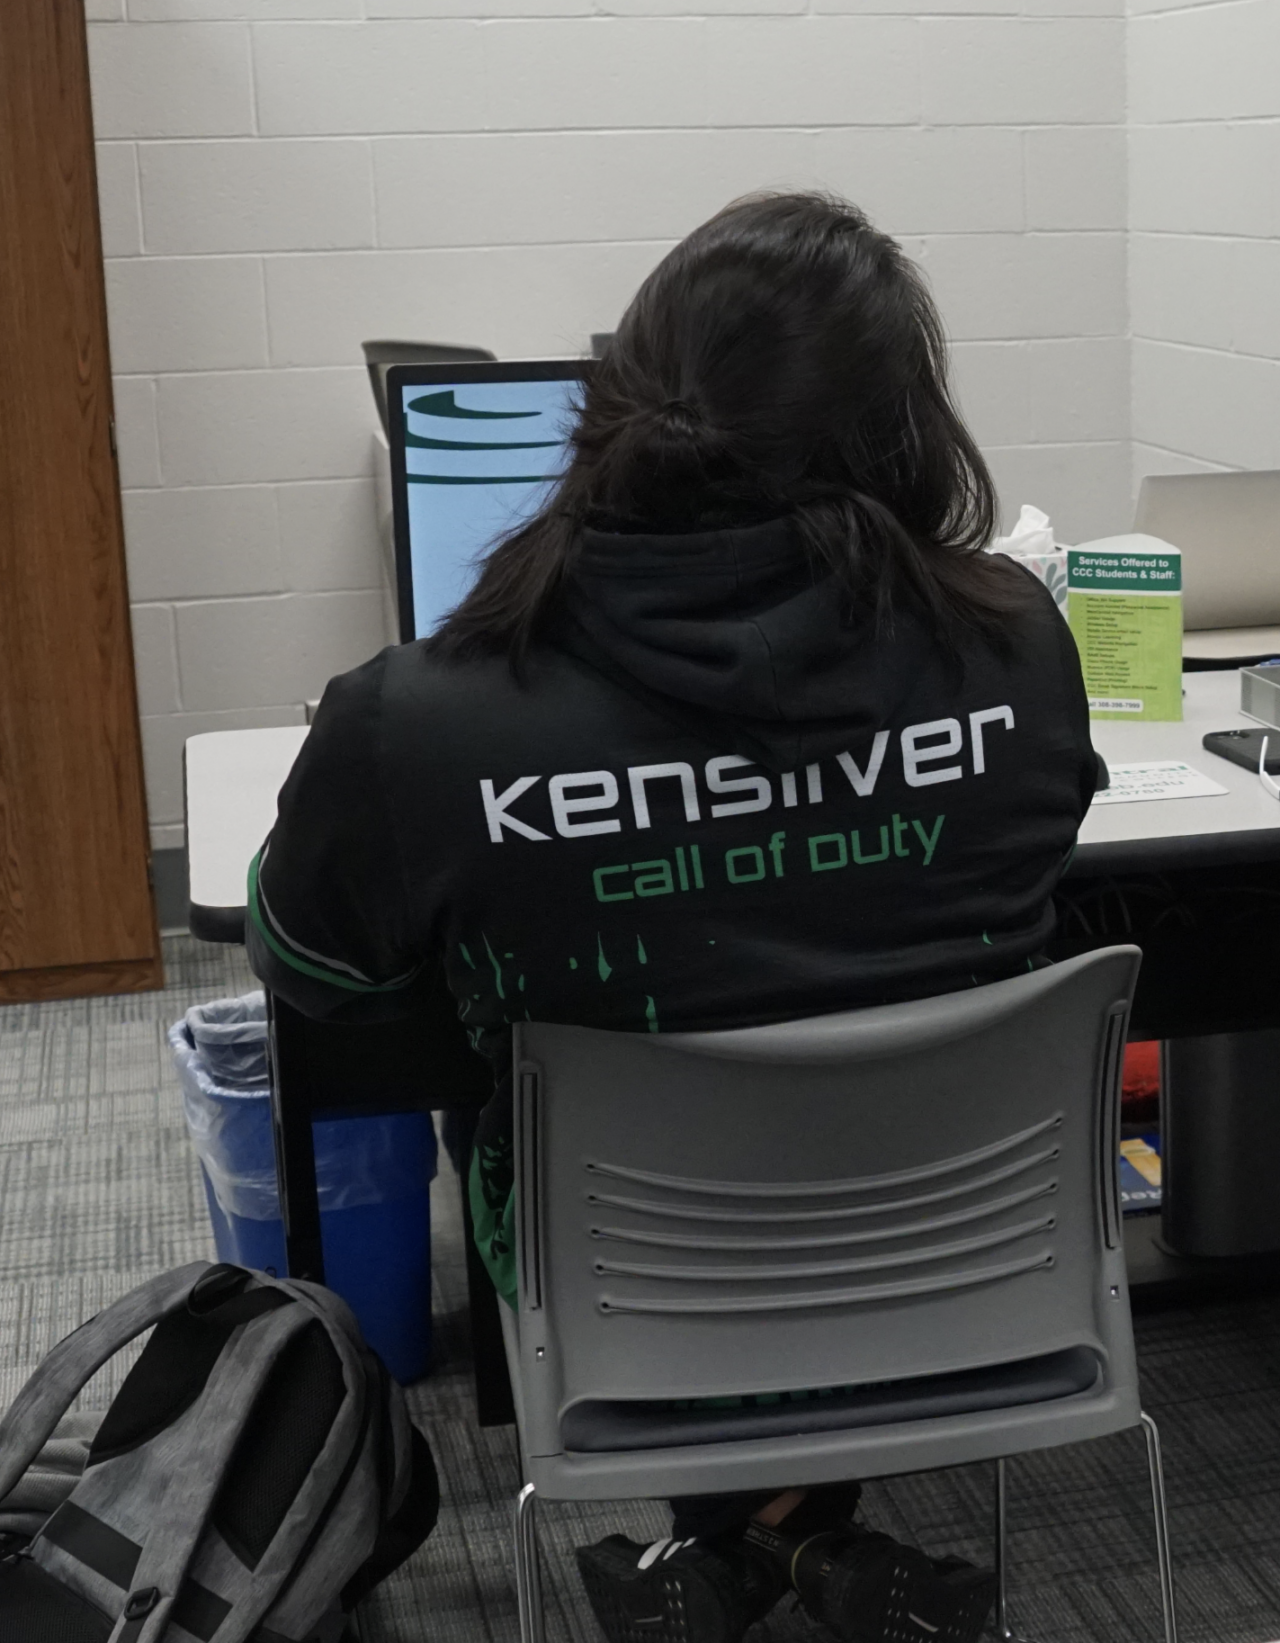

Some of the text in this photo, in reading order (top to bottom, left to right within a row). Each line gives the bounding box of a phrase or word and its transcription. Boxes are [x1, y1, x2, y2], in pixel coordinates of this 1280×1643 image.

[1078, 556, 1169, 568] Services Offered to
[1072, 568, 1175, 580] CCC Students & Staff:
[593, 844, 705, 902] call
[724, 831, 786, 884] of
